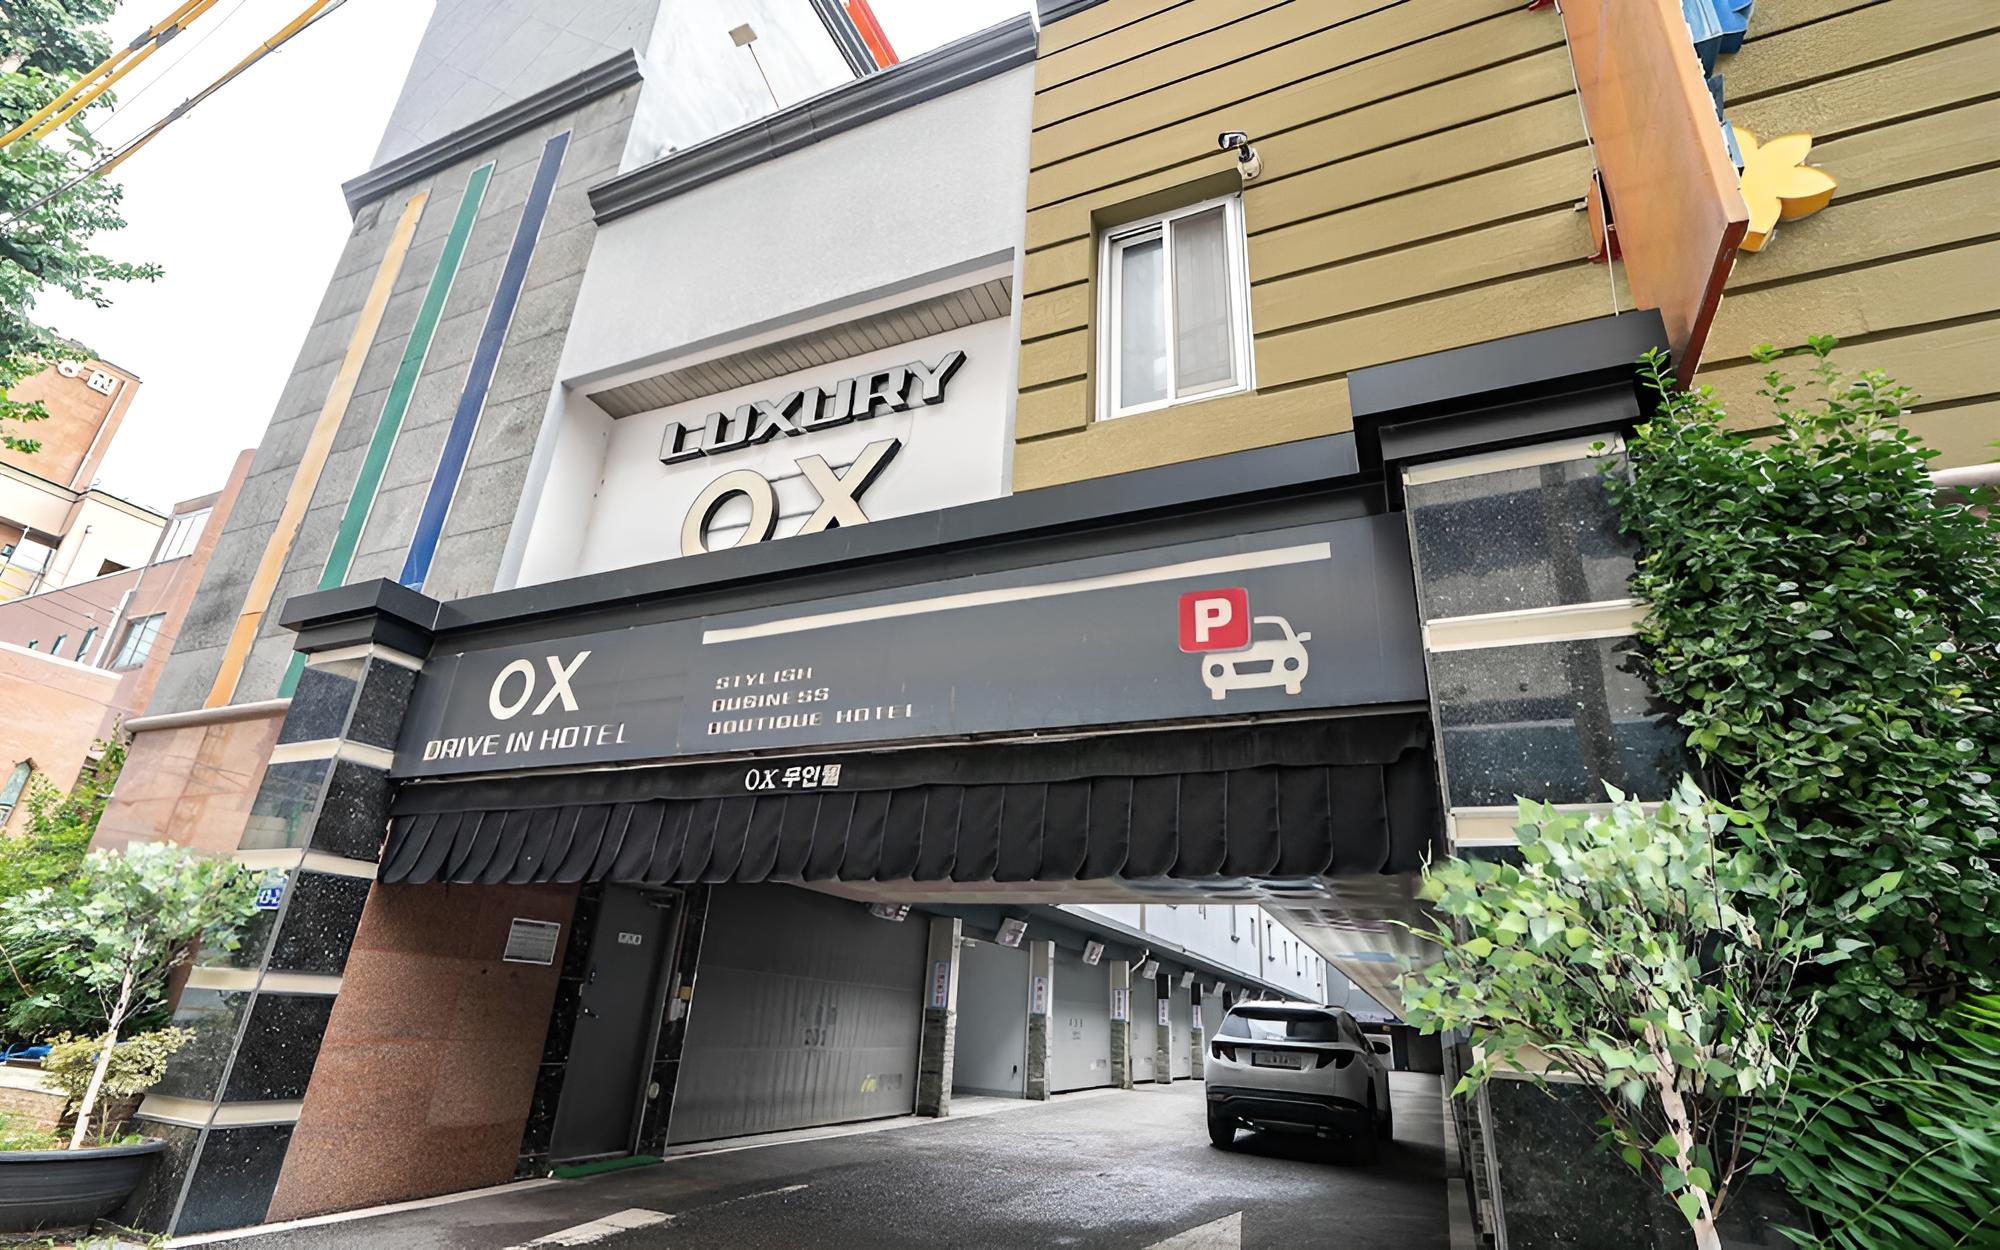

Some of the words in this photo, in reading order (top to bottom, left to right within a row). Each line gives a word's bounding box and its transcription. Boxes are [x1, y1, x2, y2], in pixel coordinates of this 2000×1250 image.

[659, 350, 967, 465] LUXURY
[681, 438, 902, 557] OX
[1195, 598, 1232, 643] P
[489, 650, 592, 720] OX
[422, 734, 501, 761] DRIVE
[505, 730, 534, 754] IN
[540, 722, 632, 750] HOTEL
[744, 768, 780, 791] OX
